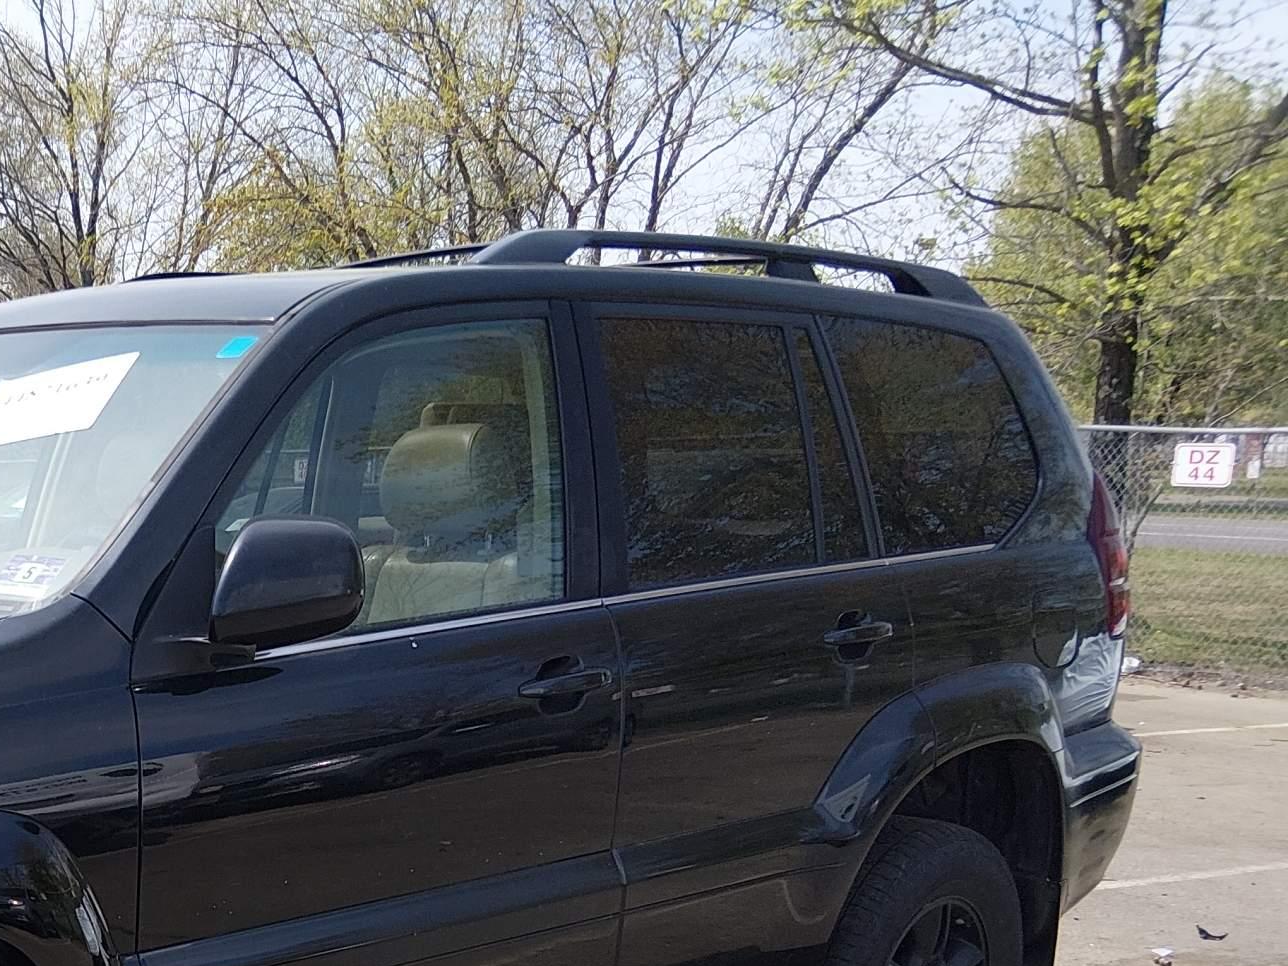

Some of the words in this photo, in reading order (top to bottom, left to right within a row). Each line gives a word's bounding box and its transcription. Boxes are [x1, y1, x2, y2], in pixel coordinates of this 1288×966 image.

[1189, 449, 1221, 465] DZ
[1187, 466, 1216, 481] 44
[22, 566, 37, 580] 5
